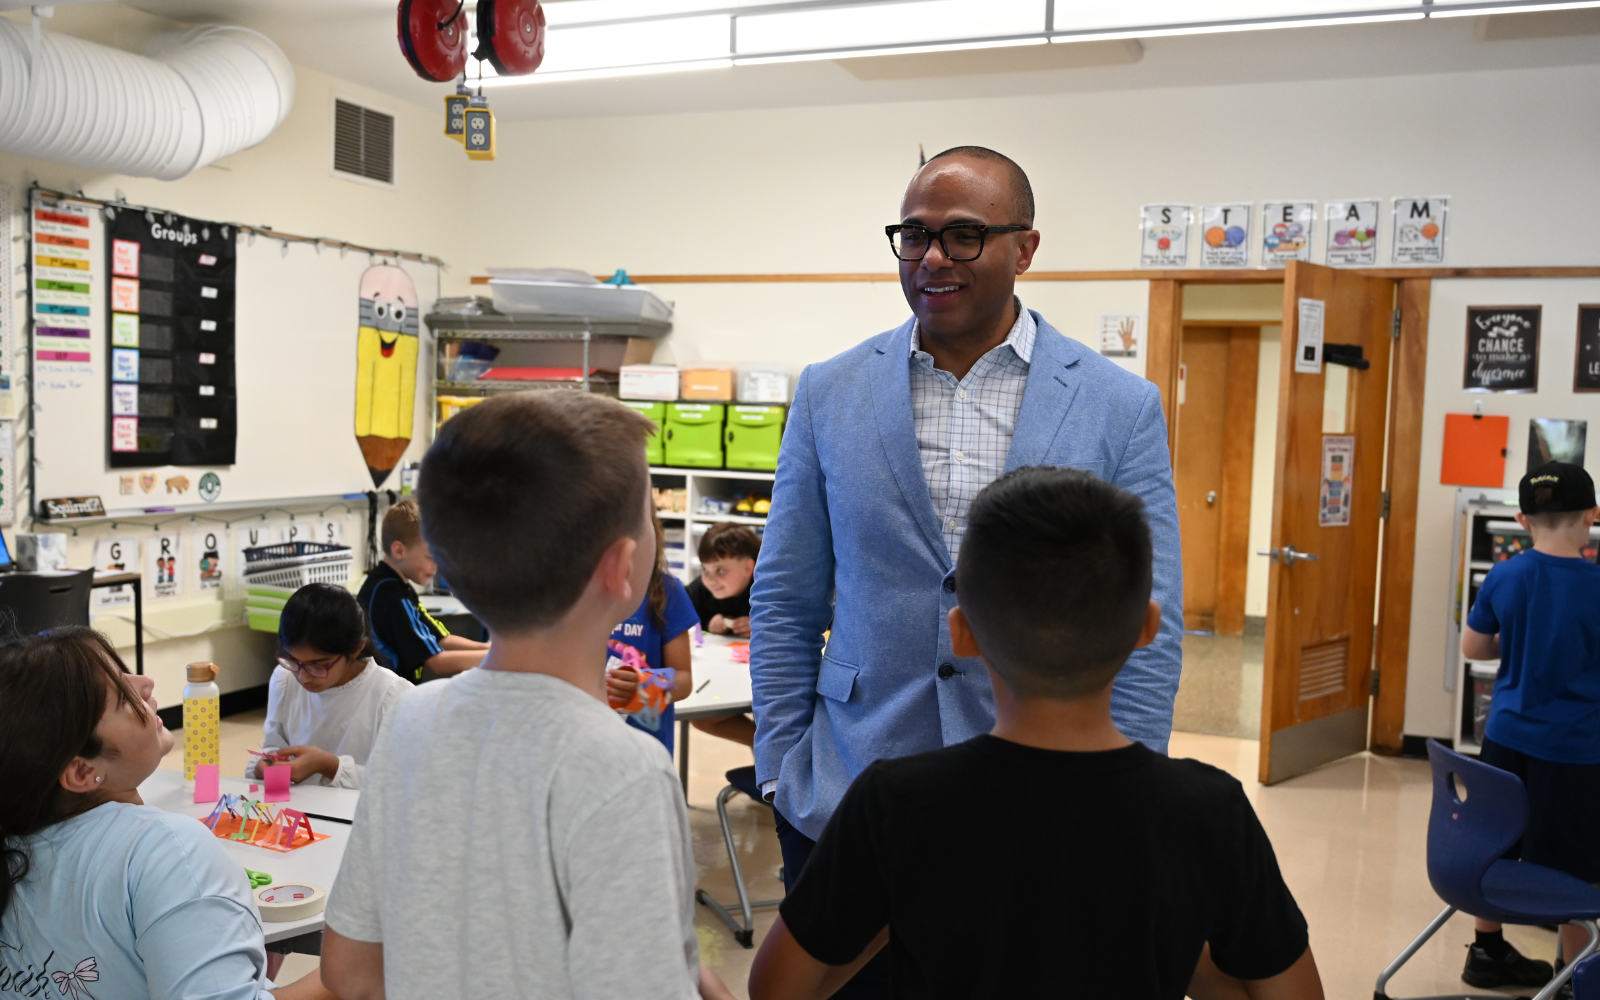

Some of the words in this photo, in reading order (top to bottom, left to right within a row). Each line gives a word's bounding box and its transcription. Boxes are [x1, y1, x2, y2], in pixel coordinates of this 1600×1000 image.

[1161, 207, 1172, 225] S
[1221, 208, 1232, 226] T
[1283, 205, 1294, 223] E
[1345, 204, 1361, 222] A
[1409, 200, 1431, 219] M
[150, 222, 198, 247] Groups
[1474, 313, 1532, 330] Everyone
[1477, 337, 1525, 354] CHANCE
[110, 542, 122, 560] G
[160, 537, 171, 556] R
[204, 532, 217, 551] O
[249, 529, 259, 546] U
[289, 526, 298, 543] P
[327, 522, 335, 538] S
[624, 623, 644, 636] DAY
